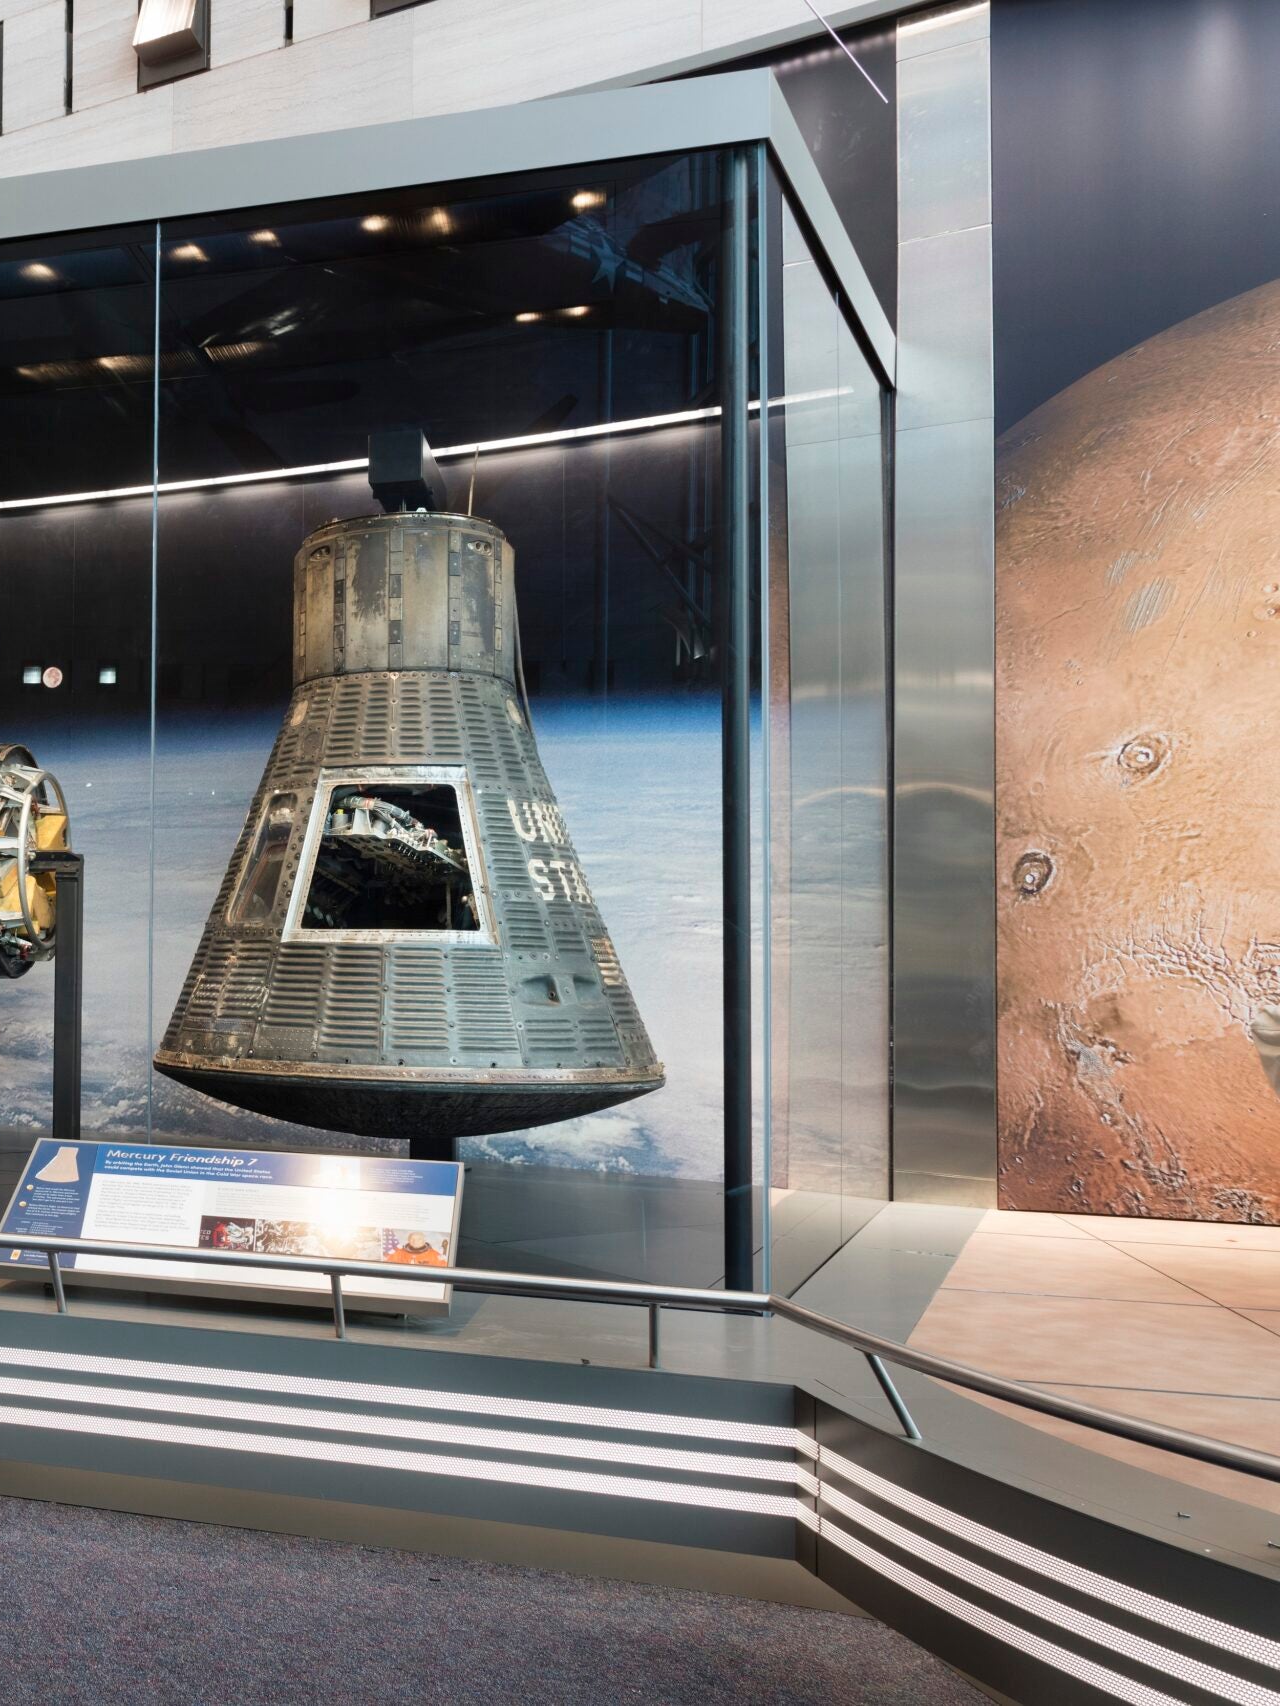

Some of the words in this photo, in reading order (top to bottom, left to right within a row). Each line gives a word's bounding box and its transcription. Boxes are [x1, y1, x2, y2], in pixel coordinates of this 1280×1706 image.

[106, 1149, 167, 1162] Mercury
[170, 1152, 245, 1167] Friendship
[247, 1158, 259, 1166] 7
